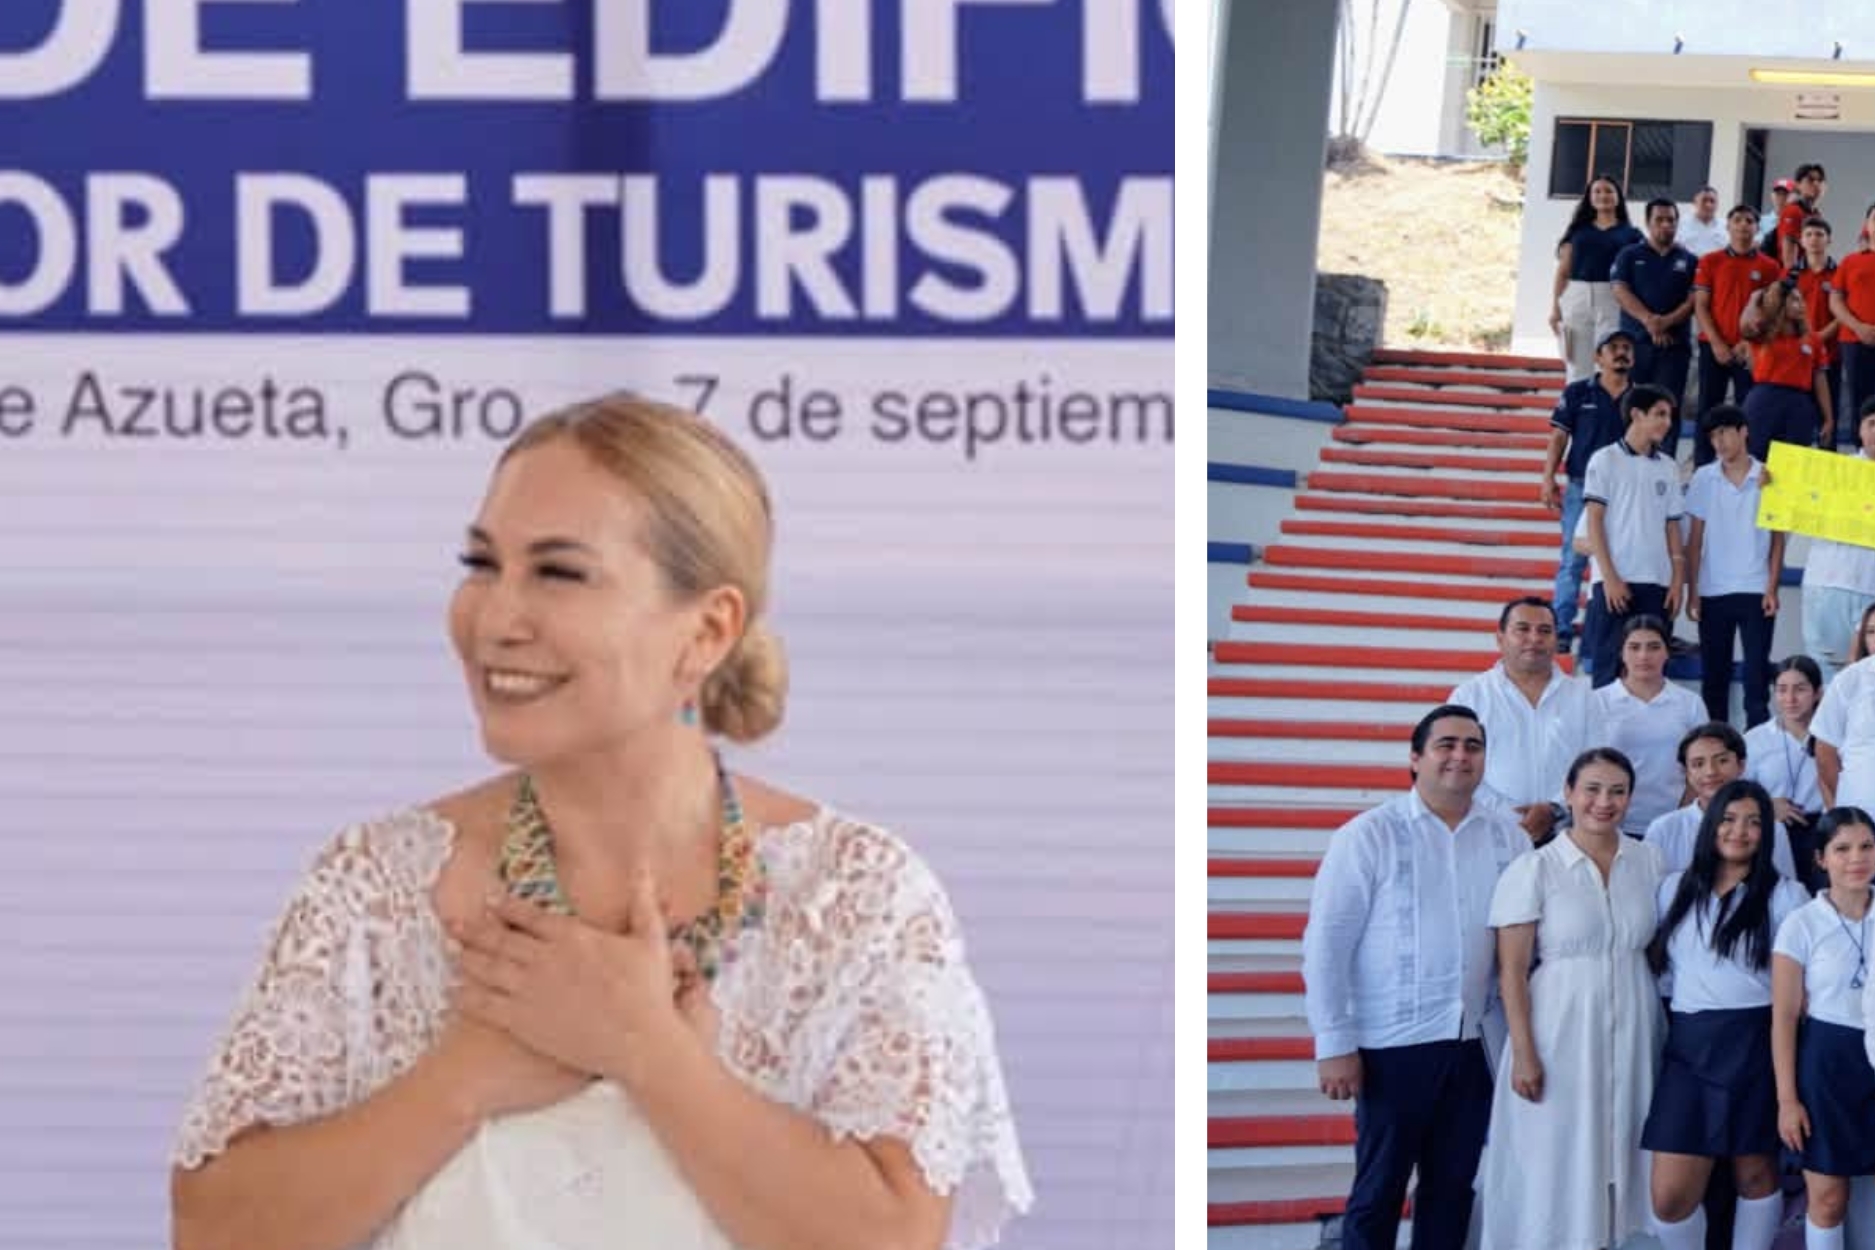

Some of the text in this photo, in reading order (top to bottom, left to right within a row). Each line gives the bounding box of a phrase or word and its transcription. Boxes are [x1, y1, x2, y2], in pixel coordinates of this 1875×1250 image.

[234, 172, 470, 317] DE
[512, 173, 1175, 322] TURISM
[61, 370, 348, 447] Azueta,
[748, 375, 842, 442] de
[870, 374, 1175, 459] septiem
